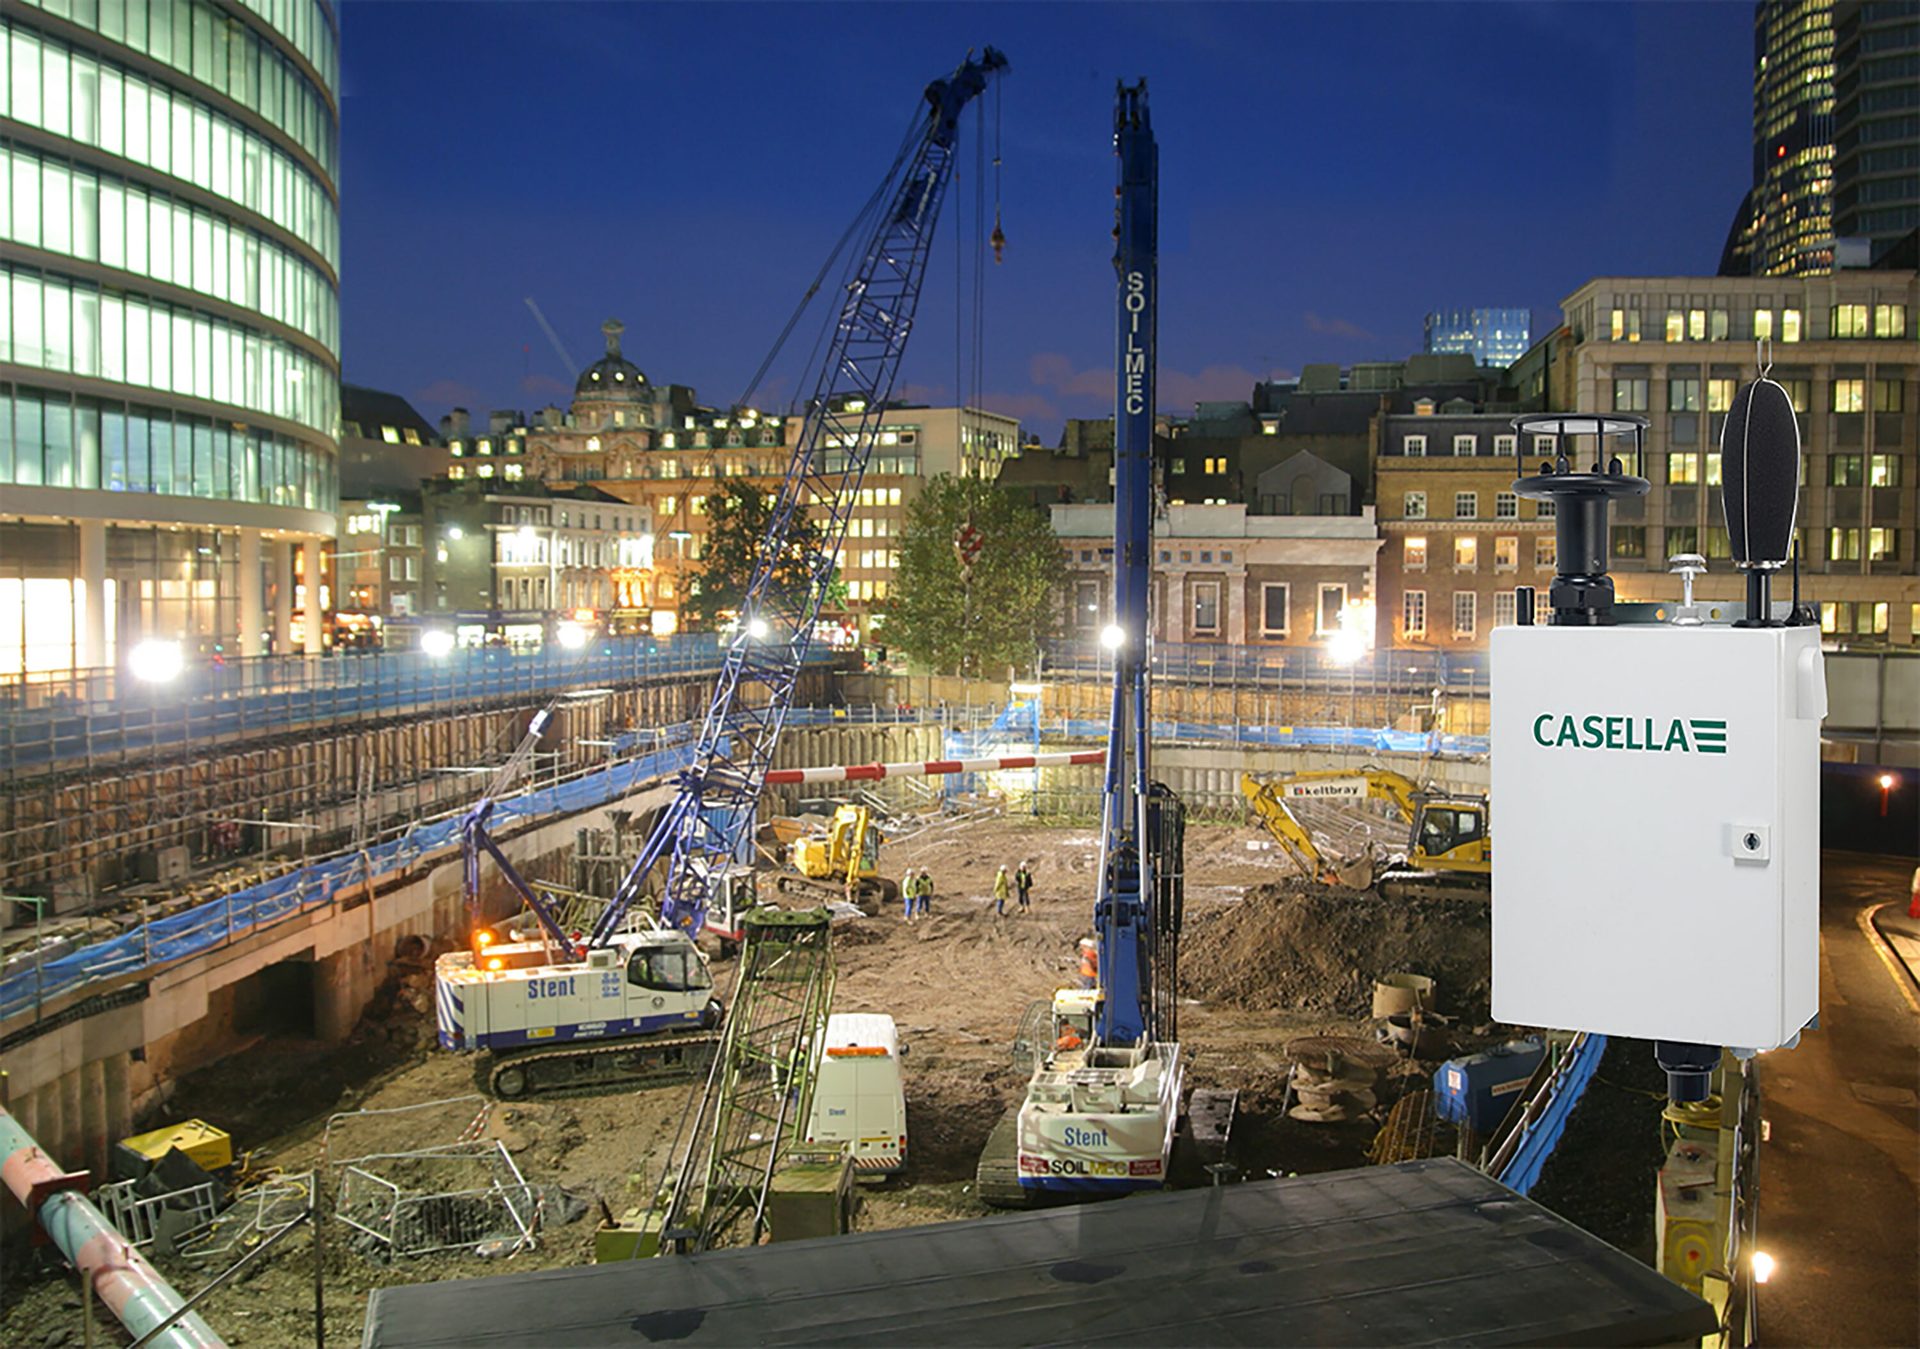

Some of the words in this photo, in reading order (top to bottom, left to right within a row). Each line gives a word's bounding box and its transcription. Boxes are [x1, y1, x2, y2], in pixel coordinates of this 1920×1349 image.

[1125, 271, 1145, 415] SOILMEC
[1533, 714, 1690, 752] CASELLA
[1305, 785, 1358, 795] keltbray
[528, 976, 576, 999] Stent
[1064, 1127, 1108, 1147] Stent
